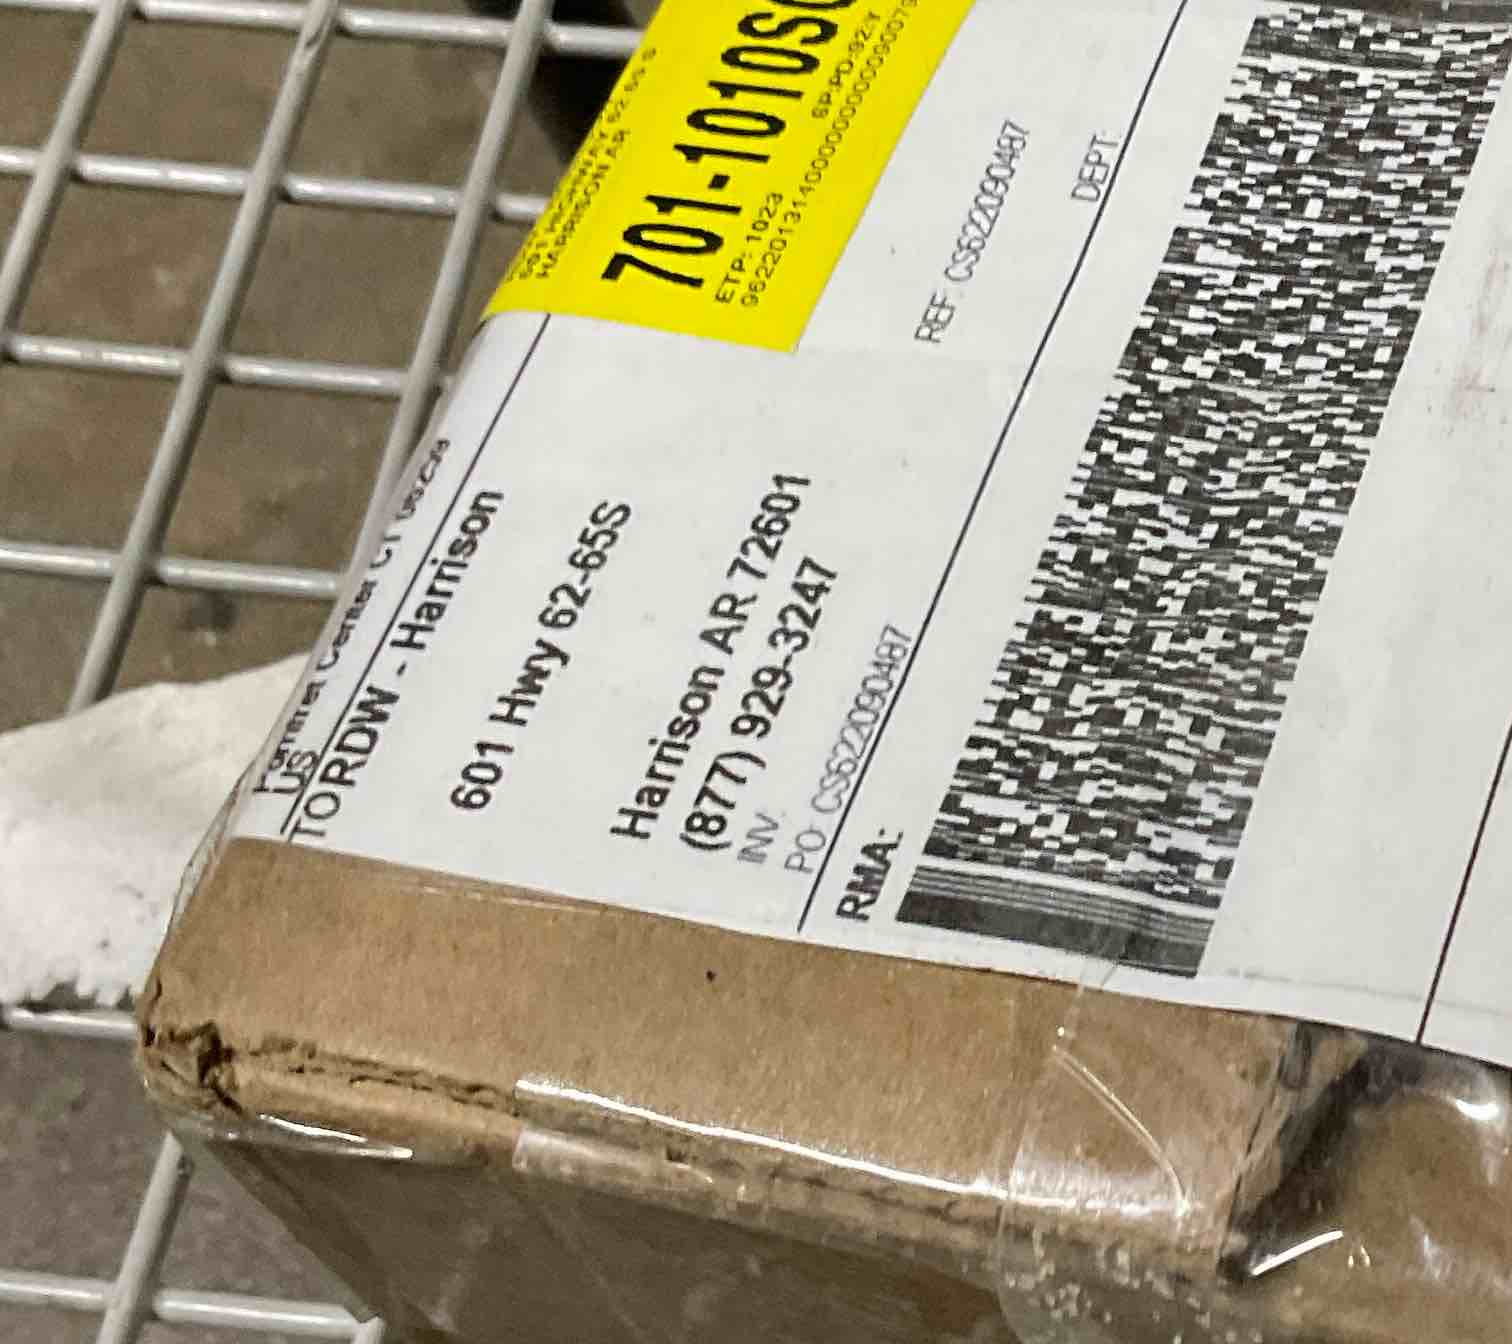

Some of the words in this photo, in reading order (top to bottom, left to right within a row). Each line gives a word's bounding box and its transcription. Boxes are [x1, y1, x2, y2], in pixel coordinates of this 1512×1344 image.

[715, 252, 752, 305] ETP:
[746, 192, 783, 244] 1023
[944, 119, 1030, 281] CS622090487
[389, 490, 505, 650] Harrison
[726, 473, 811, 581] 72601
[450, 741, 515, 810] 601
[489, 637, 571, 727] Hwy
[538, 501, 632, 630] 62-65S
[679, 751, 767, 852] (877)
[730, 556, 838, 738] 929-3247
[700, 592, 757, 655] AR
[610, 664, 725, 839] Harrison
[811, 624, 911, 813] CS622090487
[836, 828, 903, 922] RMA:
